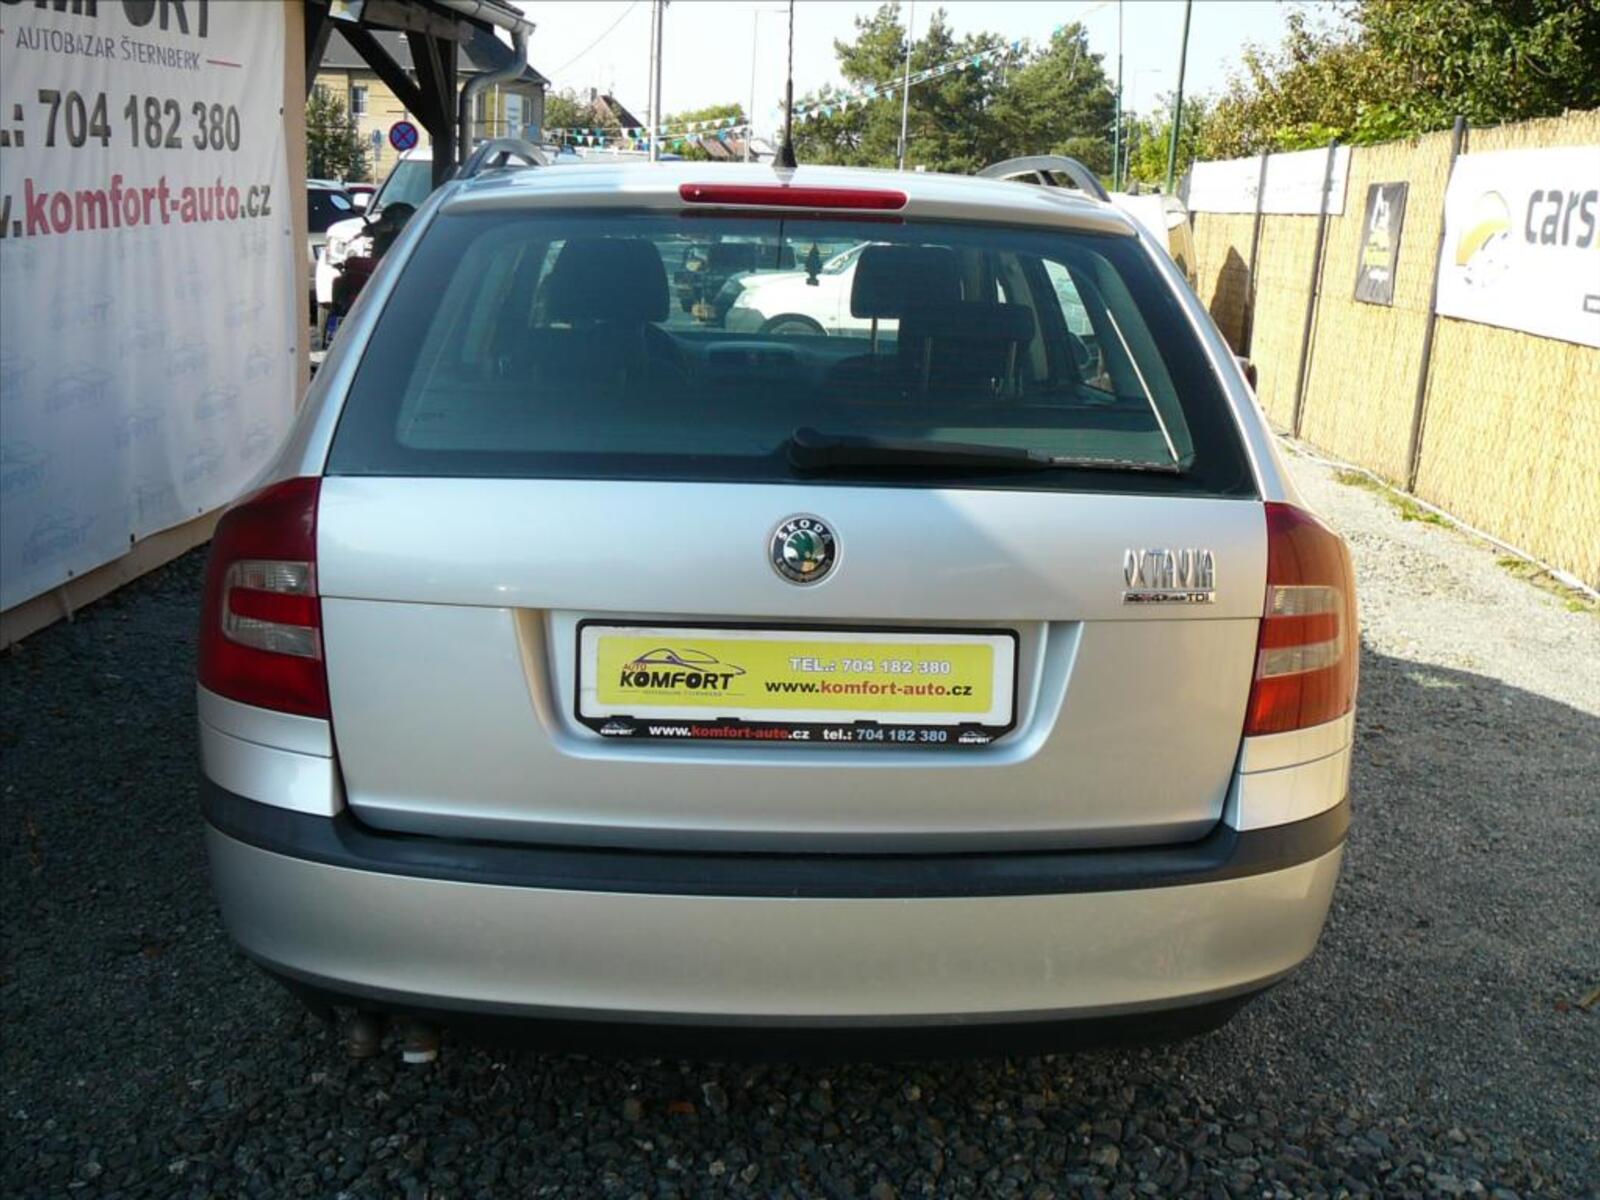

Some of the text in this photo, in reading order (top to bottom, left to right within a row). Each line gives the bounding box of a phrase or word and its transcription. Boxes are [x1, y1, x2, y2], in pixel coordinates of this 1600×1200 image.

[15, 27, 201, 71] AUTOBAZAR ŠTERNBERK
[38, 89, 112, 148] 704
[124, 94, 183, 149] 182
[192, 101, 241, 152] 380
[790, 658, 952, 675] TEL.: 704 182 380
[619, 671, 735, 690] KOMFORT
[765, 680, 973, 697] www.komfort-auto.cz
[649, 724, 811, 740] www.komfort-auto.cz
[823, 728, 853, 741] tel.:
[856, 728, 885, 742] 704
[889, 729, 916, 742] 182
[920, 729, 948, 743] 380
